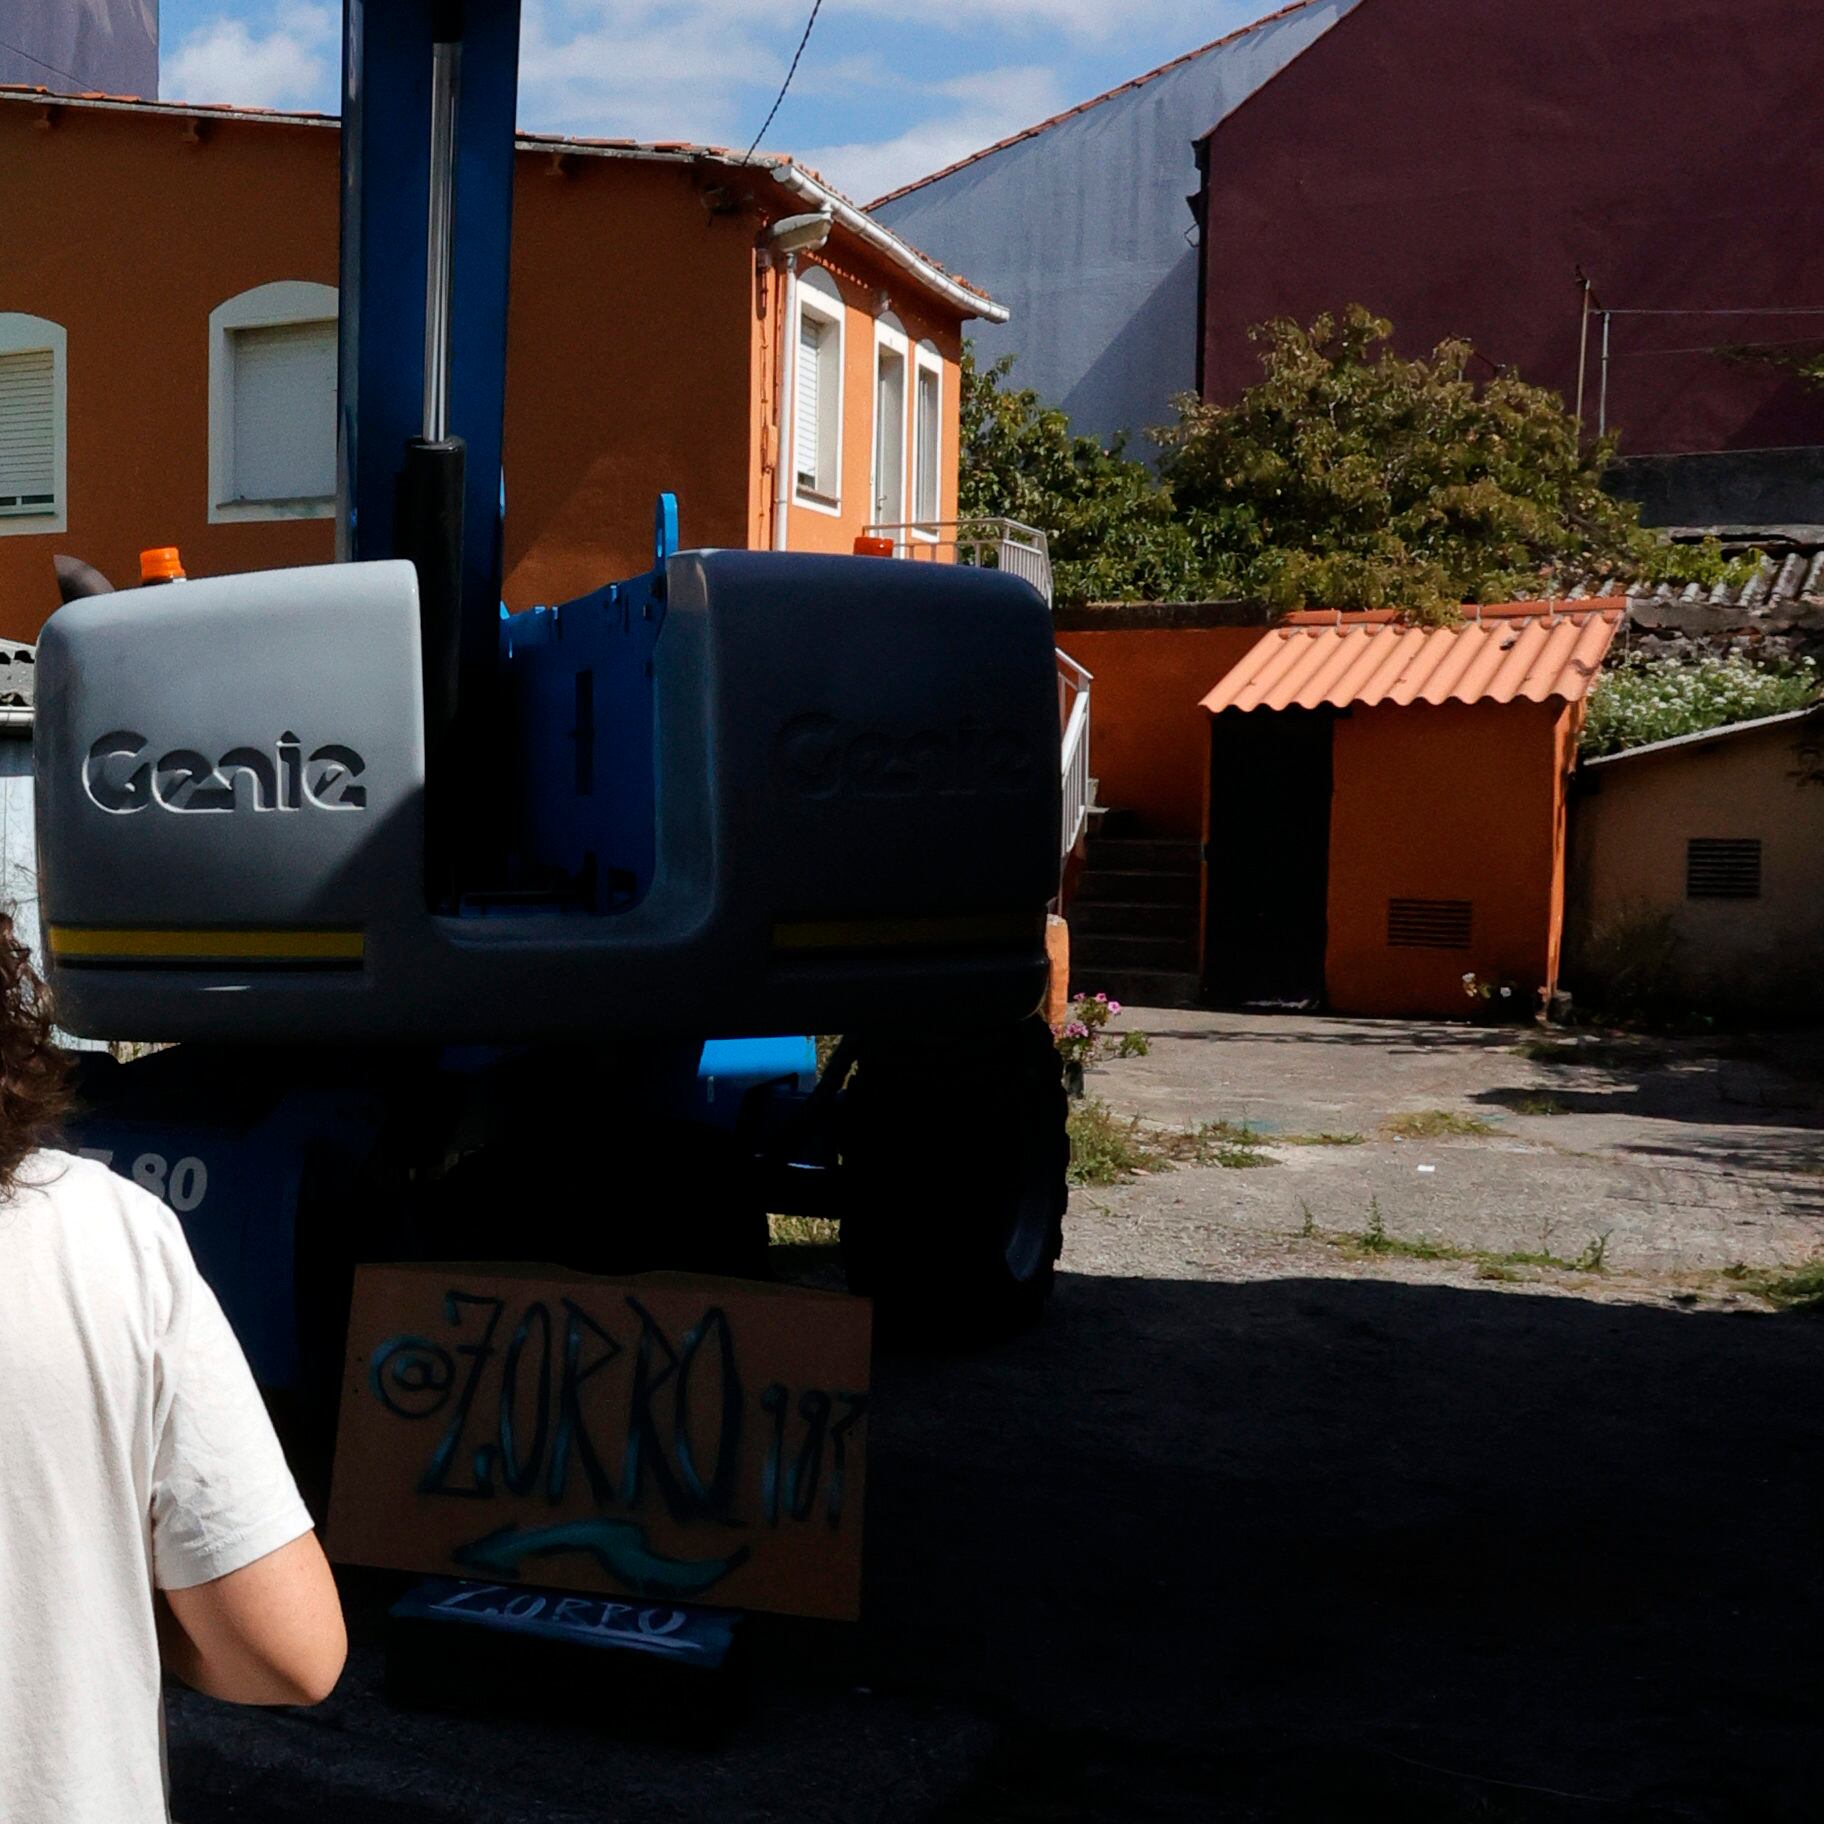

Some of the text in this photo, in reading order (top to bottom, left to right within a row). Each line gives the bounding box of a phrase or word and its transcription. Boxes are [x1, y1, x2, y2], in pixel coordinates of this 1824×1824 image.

[84, 729, 367, 814] Genie
[776, 706, 1036, 800] Genie
[428, 1586, 688, 1637] ZORRO
